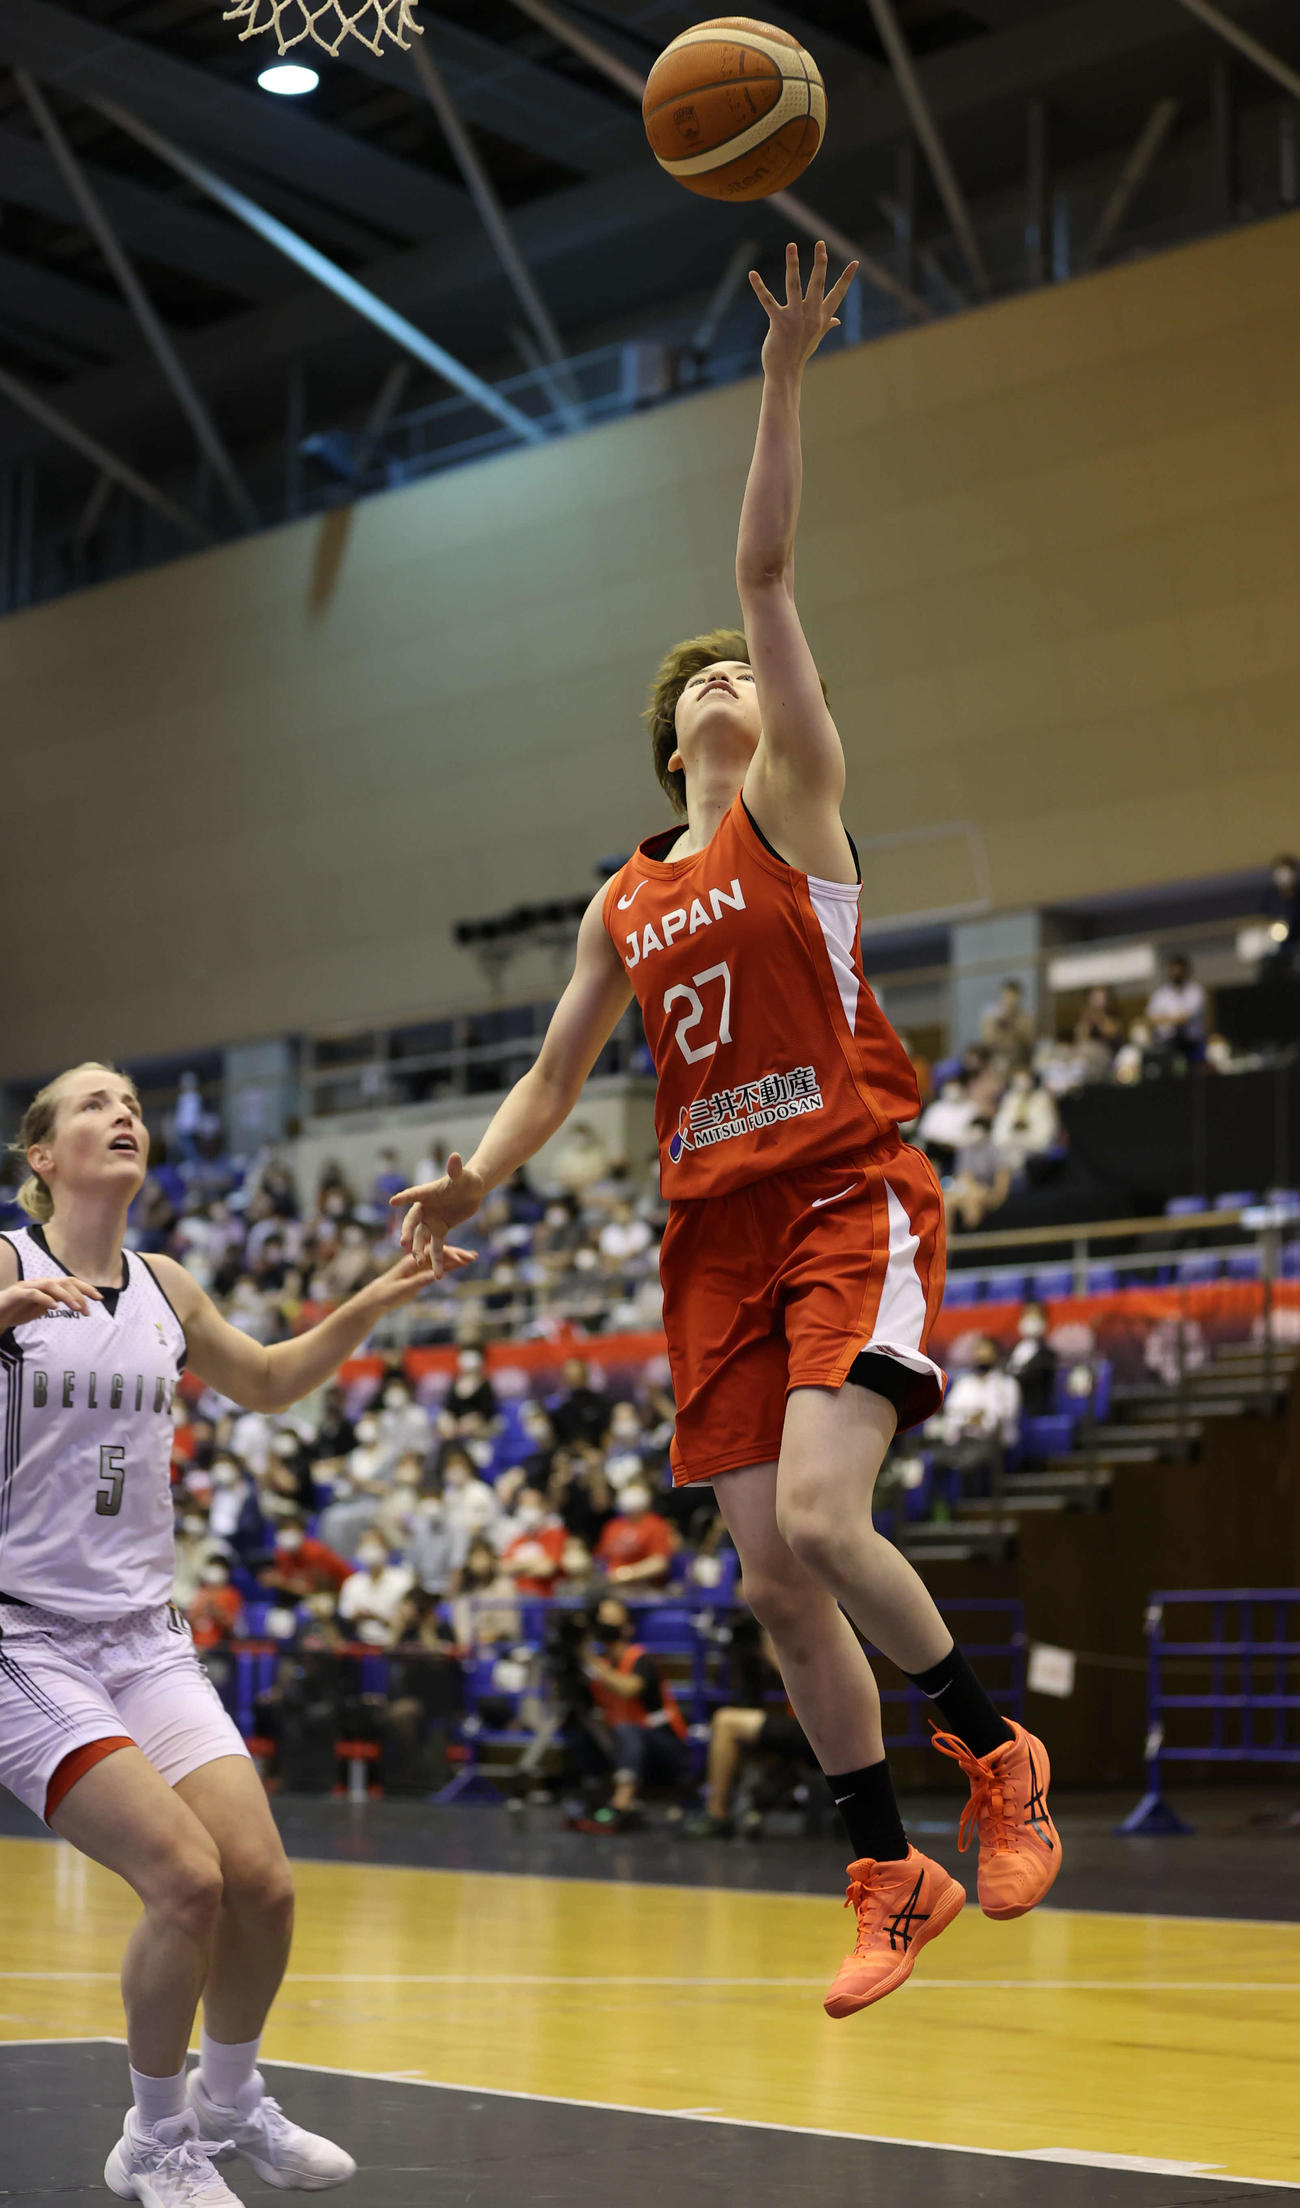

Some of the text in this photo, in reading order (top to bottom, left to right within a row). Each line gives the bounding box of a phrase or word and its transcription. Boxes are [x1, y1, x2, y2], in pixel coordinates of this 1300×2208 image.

[625, 878, 746, 969] JAPAN
[663, 961, 732, 1065] 27
[689, 1066, 819, 1130] 三井不動産
[693, 1093, 824, 1149] MITSUI FUDOSAN
[38, 1309, 80, 1320] ALDING
[96, 1445, 125, 1515] 5
